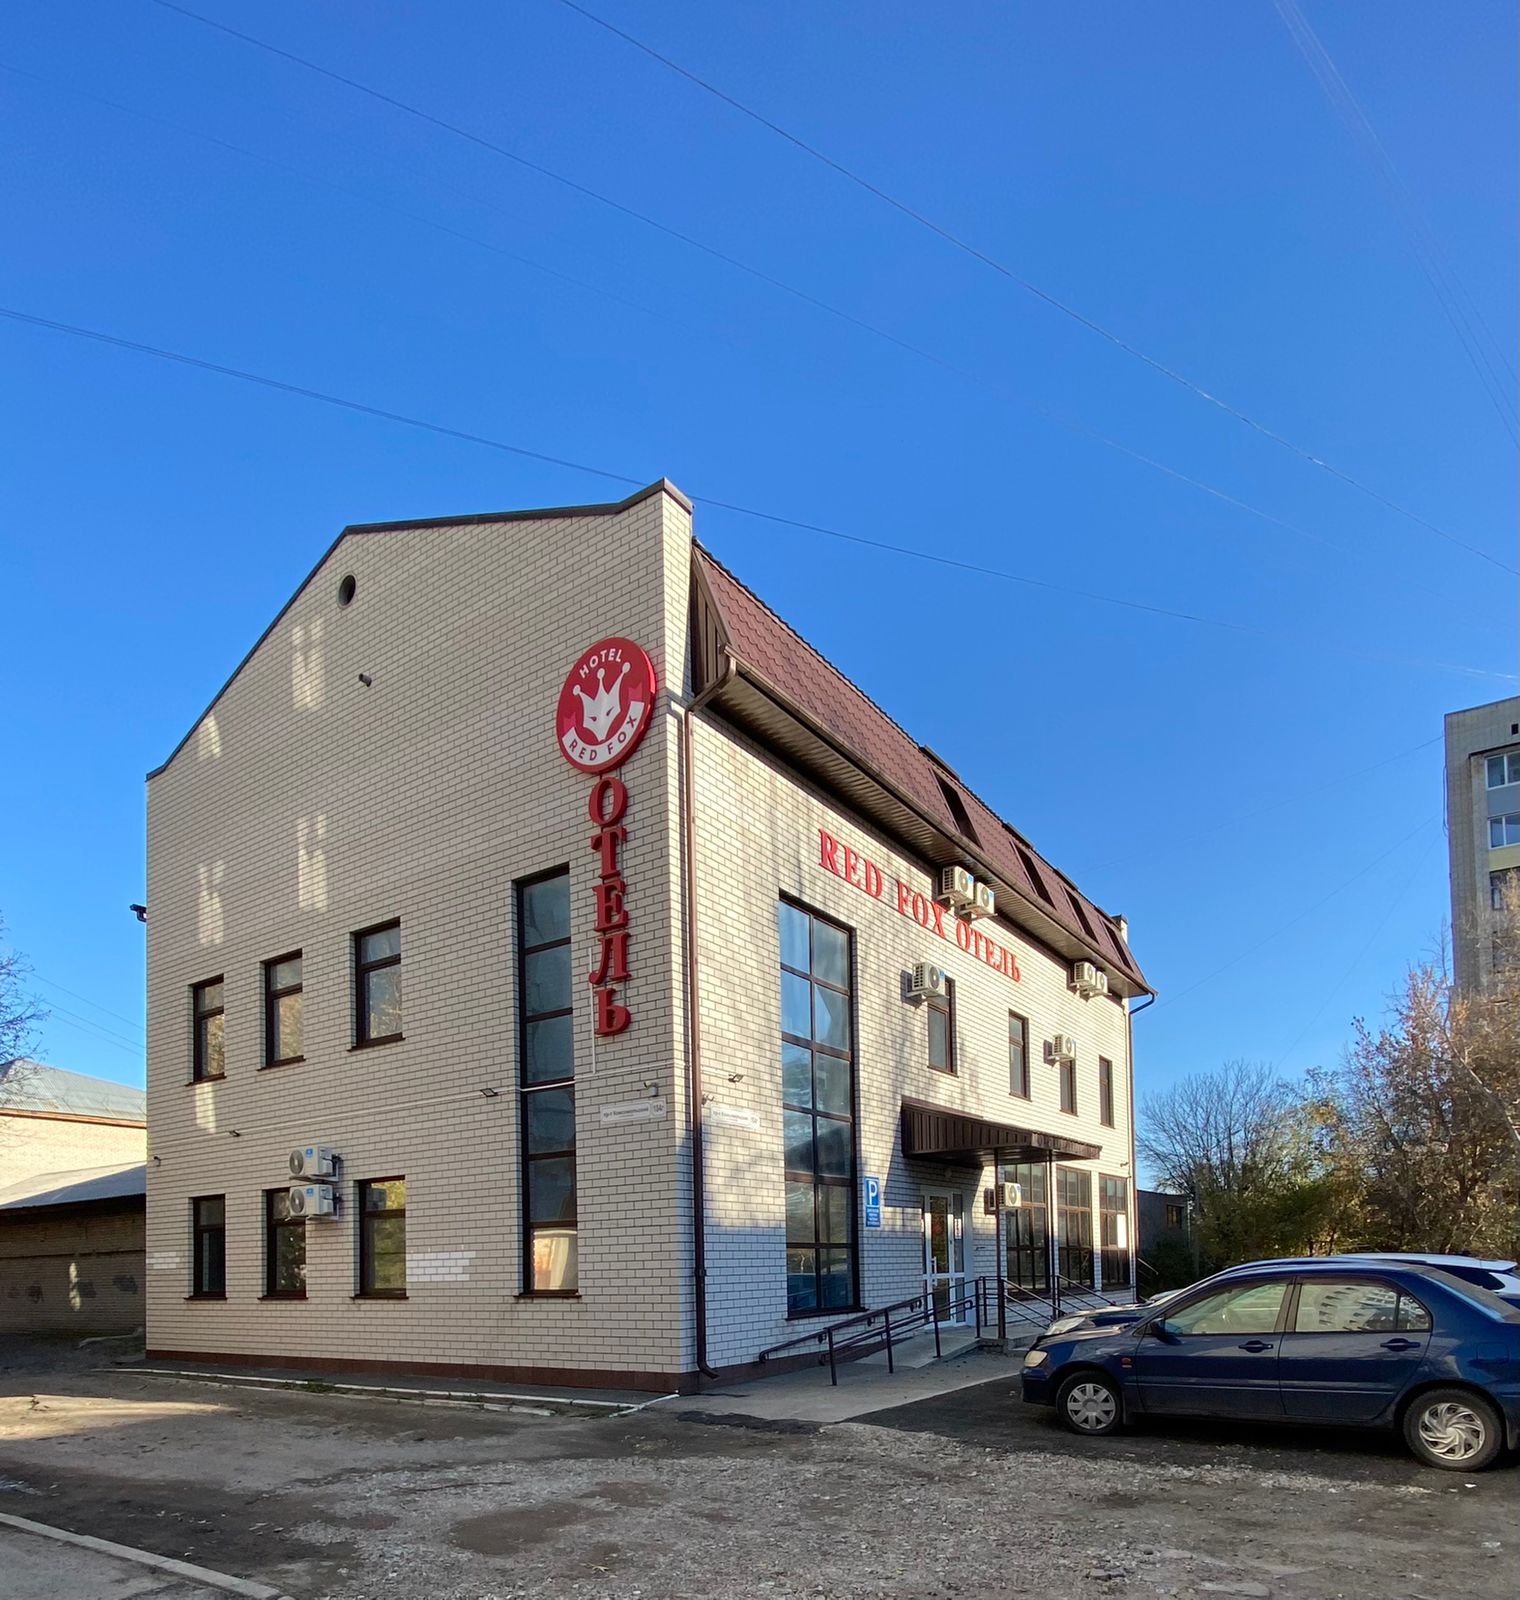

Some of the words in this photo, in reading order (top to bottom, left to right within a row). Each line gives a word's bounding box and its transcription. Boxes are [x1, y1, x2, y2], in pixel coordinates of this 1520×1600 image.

[579, 648, 622, 678] HOTEL
[569, 739, 597, 761] RED
[607, 715, 637, 754] FOX
[588, 776, 631, 1036] ОТЕЛЬ
[818, 828, 883, 900] RED
[895, 878, 948, 940] FOX
[956, 918, 1021, 983] ОТЕЛЬ
[868, 1180, 878, 1206] P
